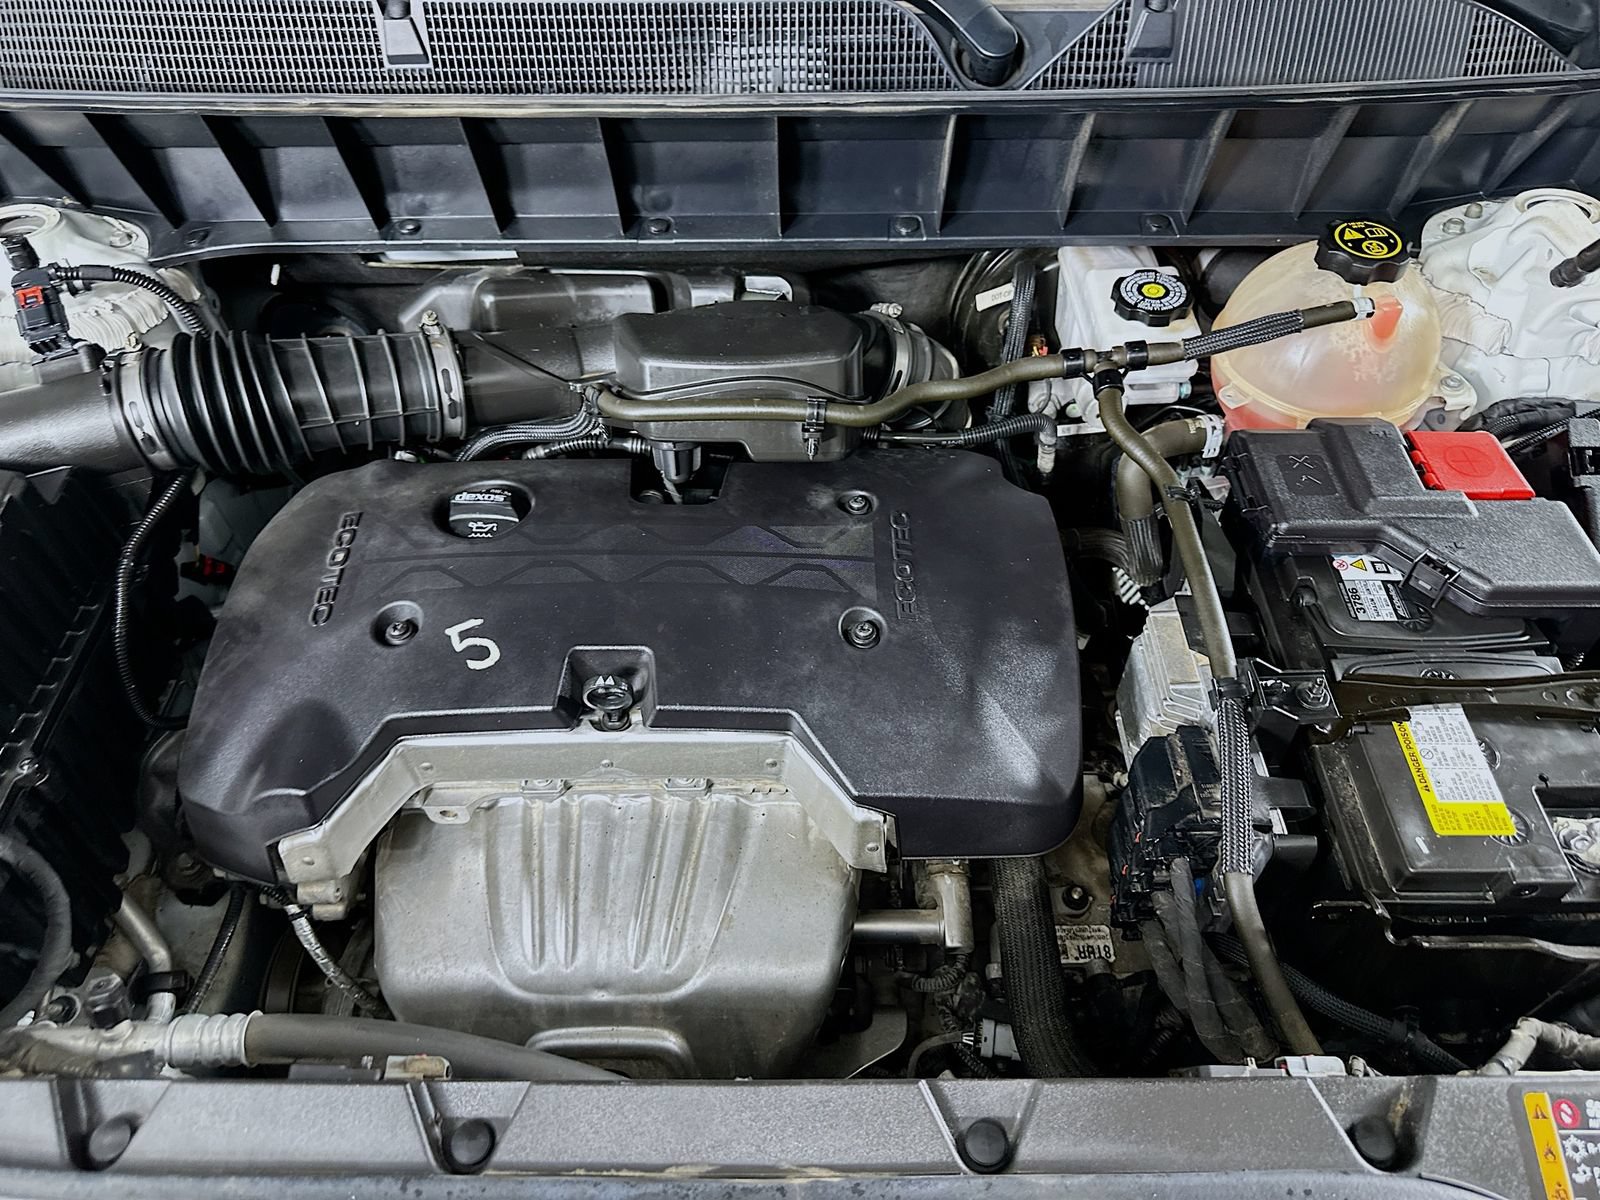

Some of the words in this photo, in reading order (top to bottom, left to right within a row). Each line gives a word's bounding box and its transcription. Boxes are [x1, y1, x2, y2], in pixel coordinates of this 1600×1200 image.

[454, 491, 507, 502] dexos
[307, 511, 363, 627] ECOTEC
[890, 511, 919, 621] ECOTEC
[1347, 587, 1367, 615] 3786
[444, 617, 501, 671] 5
